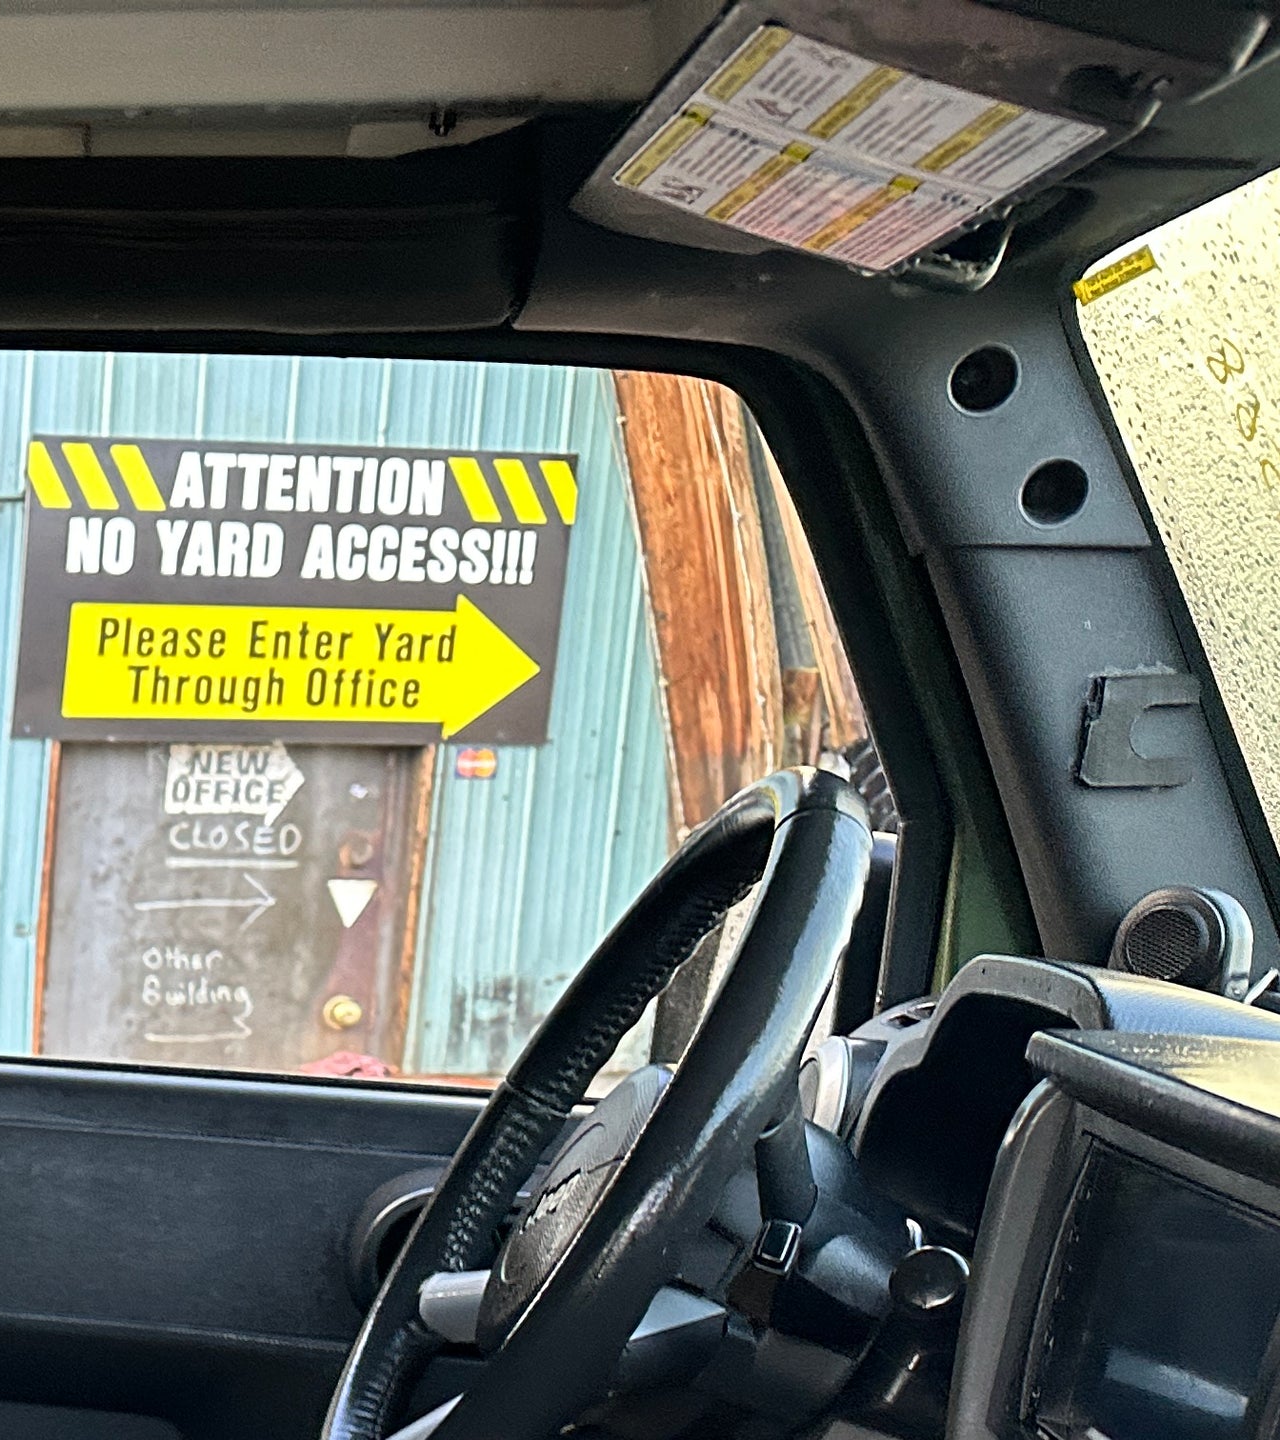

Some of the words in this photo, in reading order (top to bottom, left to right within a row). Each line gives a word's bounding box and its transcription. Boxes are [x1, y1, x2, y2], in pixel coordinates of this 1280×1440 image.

[170, 451, 445, 516] ATTENTION
[66, 516, 136, 575] NO
[157, 519, 284, 578] YARD
[300, 524, 537, 585] ACCESS!!!
[98, 618, 226, 659] Please
[249, 620, 353, 661] Enter
[375, 622, 456, 663] Yard
[128, 666, 284, 713] Through
[306, 668, 420, 708] Office
[190, 751, 269, 775] NEW
[172, 778, 286, 805] OFFICE
[169, 820, 302, 855] CLOSED
[142, 974, 253, 1017] Building
